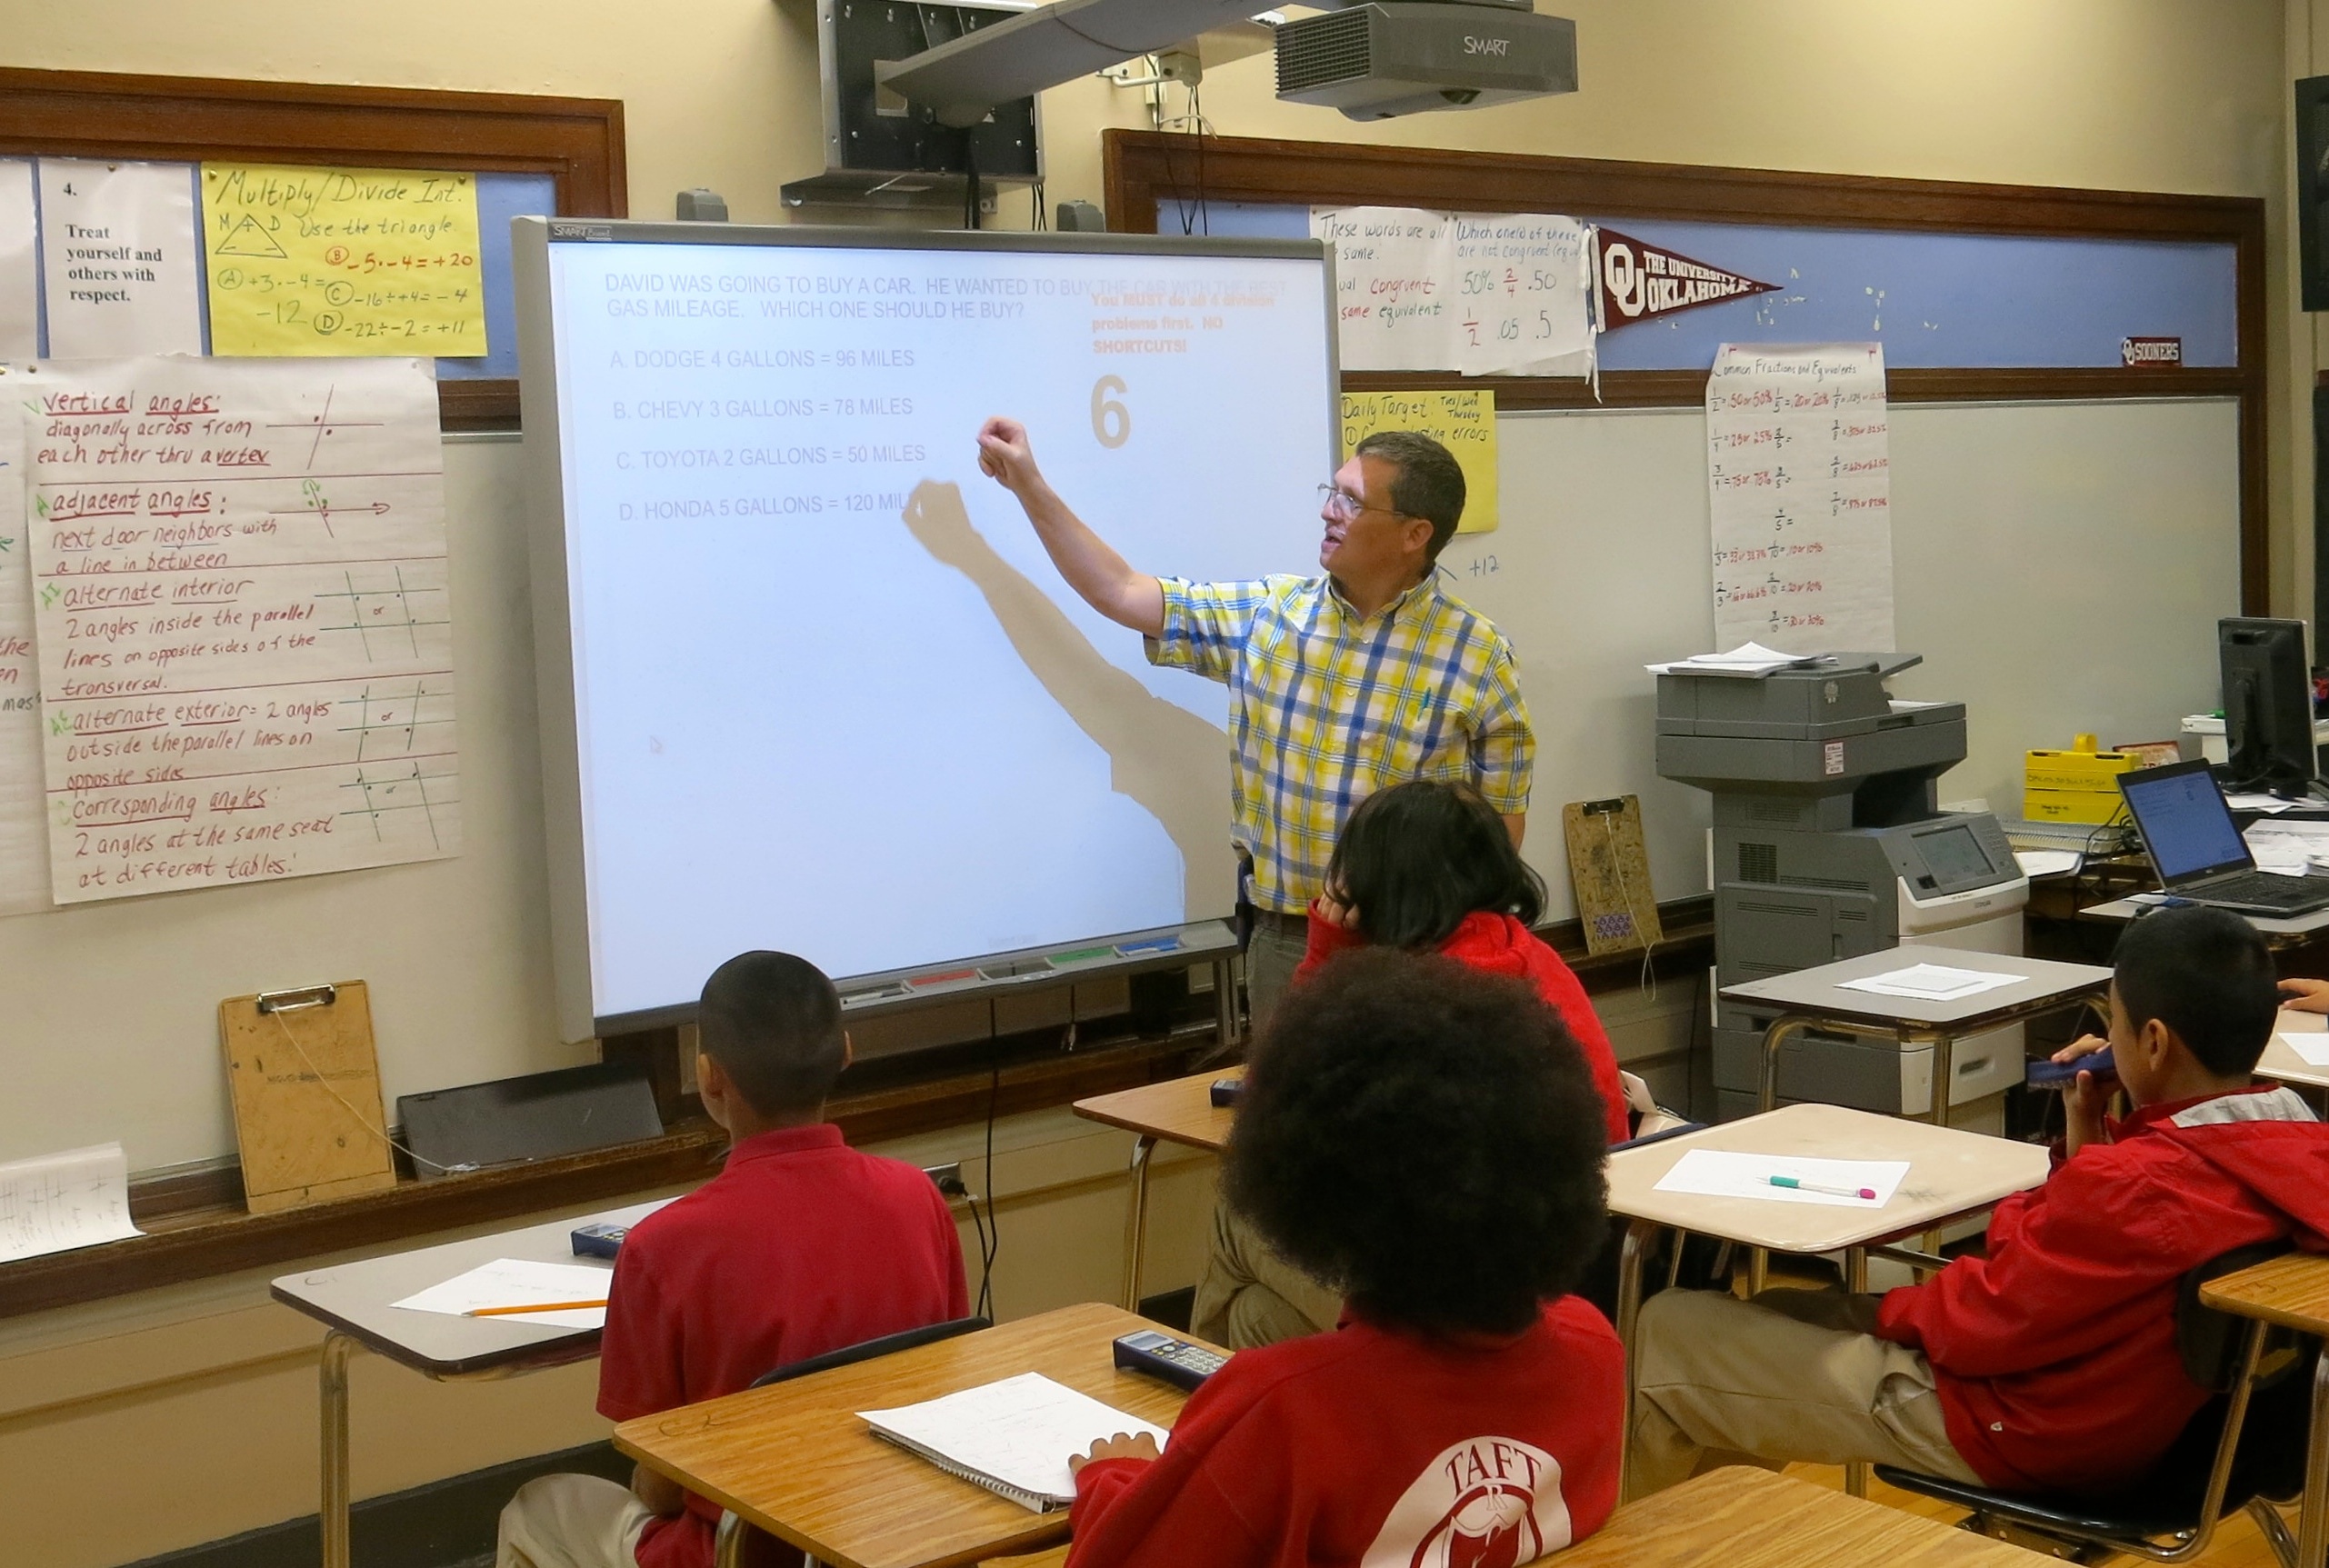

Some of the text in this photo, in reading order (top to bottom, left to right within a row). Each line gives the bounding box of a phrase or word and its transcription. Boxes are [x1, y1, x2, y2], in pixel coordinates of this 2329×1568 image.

[1464, 36, 1510, 55] SMART
[64, 184, 76, 196] 4.
[414, 175, 461, 203] Int.
[65, 225, 108, 238] Treat
[300, 218, 369, 236] Use the
[555, 226, 585, 235] SMART
[1321, 214, 1447, 239] These words are all
[1457, 221, 1576, 242] Which of these
[66, 247, 162, 263] yourself and
[1344, 248, 1379, 260] same.
[1458, 245, 1549, 265] are not congruent
[68, 266, 155, 281] others with
[1644, 251, 1736, 284] THE UNIVERSITY
[605, 274, 1286, 295] DAVID WAS GOING TO BUY A CAR. HE WANTED TO BUY THE CAR WITH THE BEST
[1462, 270, 1556, 294] 50% .50
[1604, 244, 1645, 316] OU
[70, 288, 130, 303] respect.
[1092, 294, 1118, 306] You
[1124, 294, 1164, 306] MUST
[1169, 295, 1184, 306] do
[1190, 295, 1206, 306] all
[1647, 277, 1749, 312] OKLAHOMA
[606, 300, 1024, 318] GAS MILEAGE. WHICH ONE SHOULD HE BUY?
[1341, 302, 1441, 327] same equivalent
[1092, 317, 1223, 332] problems first. NO
[1093, 340, 1186, 353] SHORTCUTS!
[2135, 343, 2178, 360] SOONERS
[610, 349, 914, 368] A. DODGE 4 GALLONS 96 MILES
[44, 390, 132, 412] vertical
[614, 398, 914, 419] B. CHEVY 3 GALLONS 78 MILES
[1091, 374, 1131, 449] 6
[1342, 396, 1376, 425] Daily
[46, 418, 251, 447] diagonally across from
[1452, 427, 1488, 442] errors
[37, 443, 266, 464] each other thru vertex
[616, 445, 925, 469] C. TOYOTA 2 GALLONS 50 MILES
[53, 490, 142, 517] adjacent
[619, 495, 875, 521] D. HONDA 5 GALLONS 120
[53, 521, 277, 549] next door neighbors with
[81, 552, 227, 573] line between
[1469, 555, 1499, 576] +12
[64, 581, 255, 607] alternate interior
[67, 604, 314, 639] 2 angles inside the parallel
[64, 634, 315, 670] lines on opposite sides of the
[74, 701, 330, 732] alternate 2 angles
[67, 730, 313, 762] outside the parallel lines on
[75, 815, 334, 856] 2 angles at the same seat
[79, 860, 215, 885] at different
[1445, 1442, 1541, 1498] TAFT
